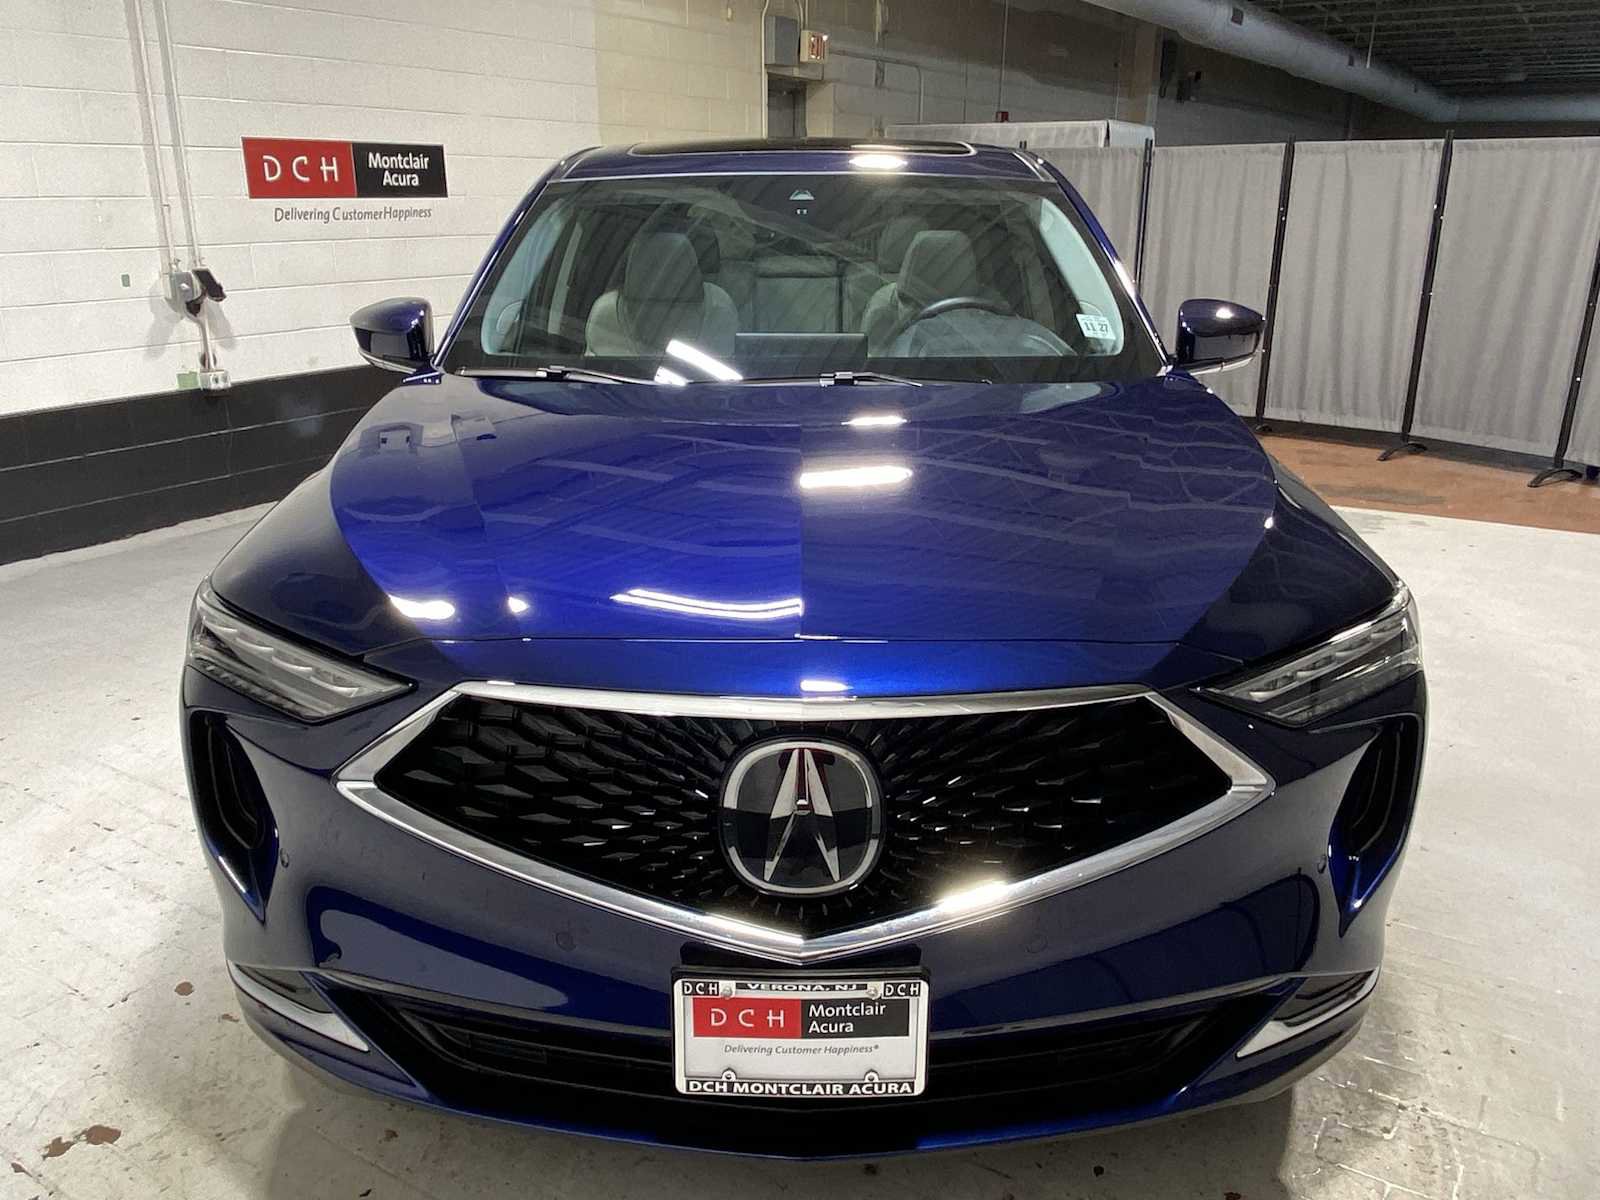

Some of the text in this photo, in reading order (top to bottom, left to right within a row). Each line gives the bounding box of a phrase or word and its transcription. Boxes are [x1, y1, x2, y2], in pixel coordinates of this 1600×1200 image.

[368, 152, 430, 170] Montclair
[382, 172, 420, 187] Acura
[274, 207, 330, 224] Delivering
[683, 983, 718, 995] DCH
[834, 983, 857, 991] NJ
[885, 984, 920, 996] DCH
[808, 1002, 887, 1018] Montclair
[808, 1021, 854, 1033] Acura
[724, 1044, 773, 1056] Delivering
[775, 1045, 822, 1055] Customer
[689, 1081, 912, 1095] DCH MONTCLAIR ACURA
